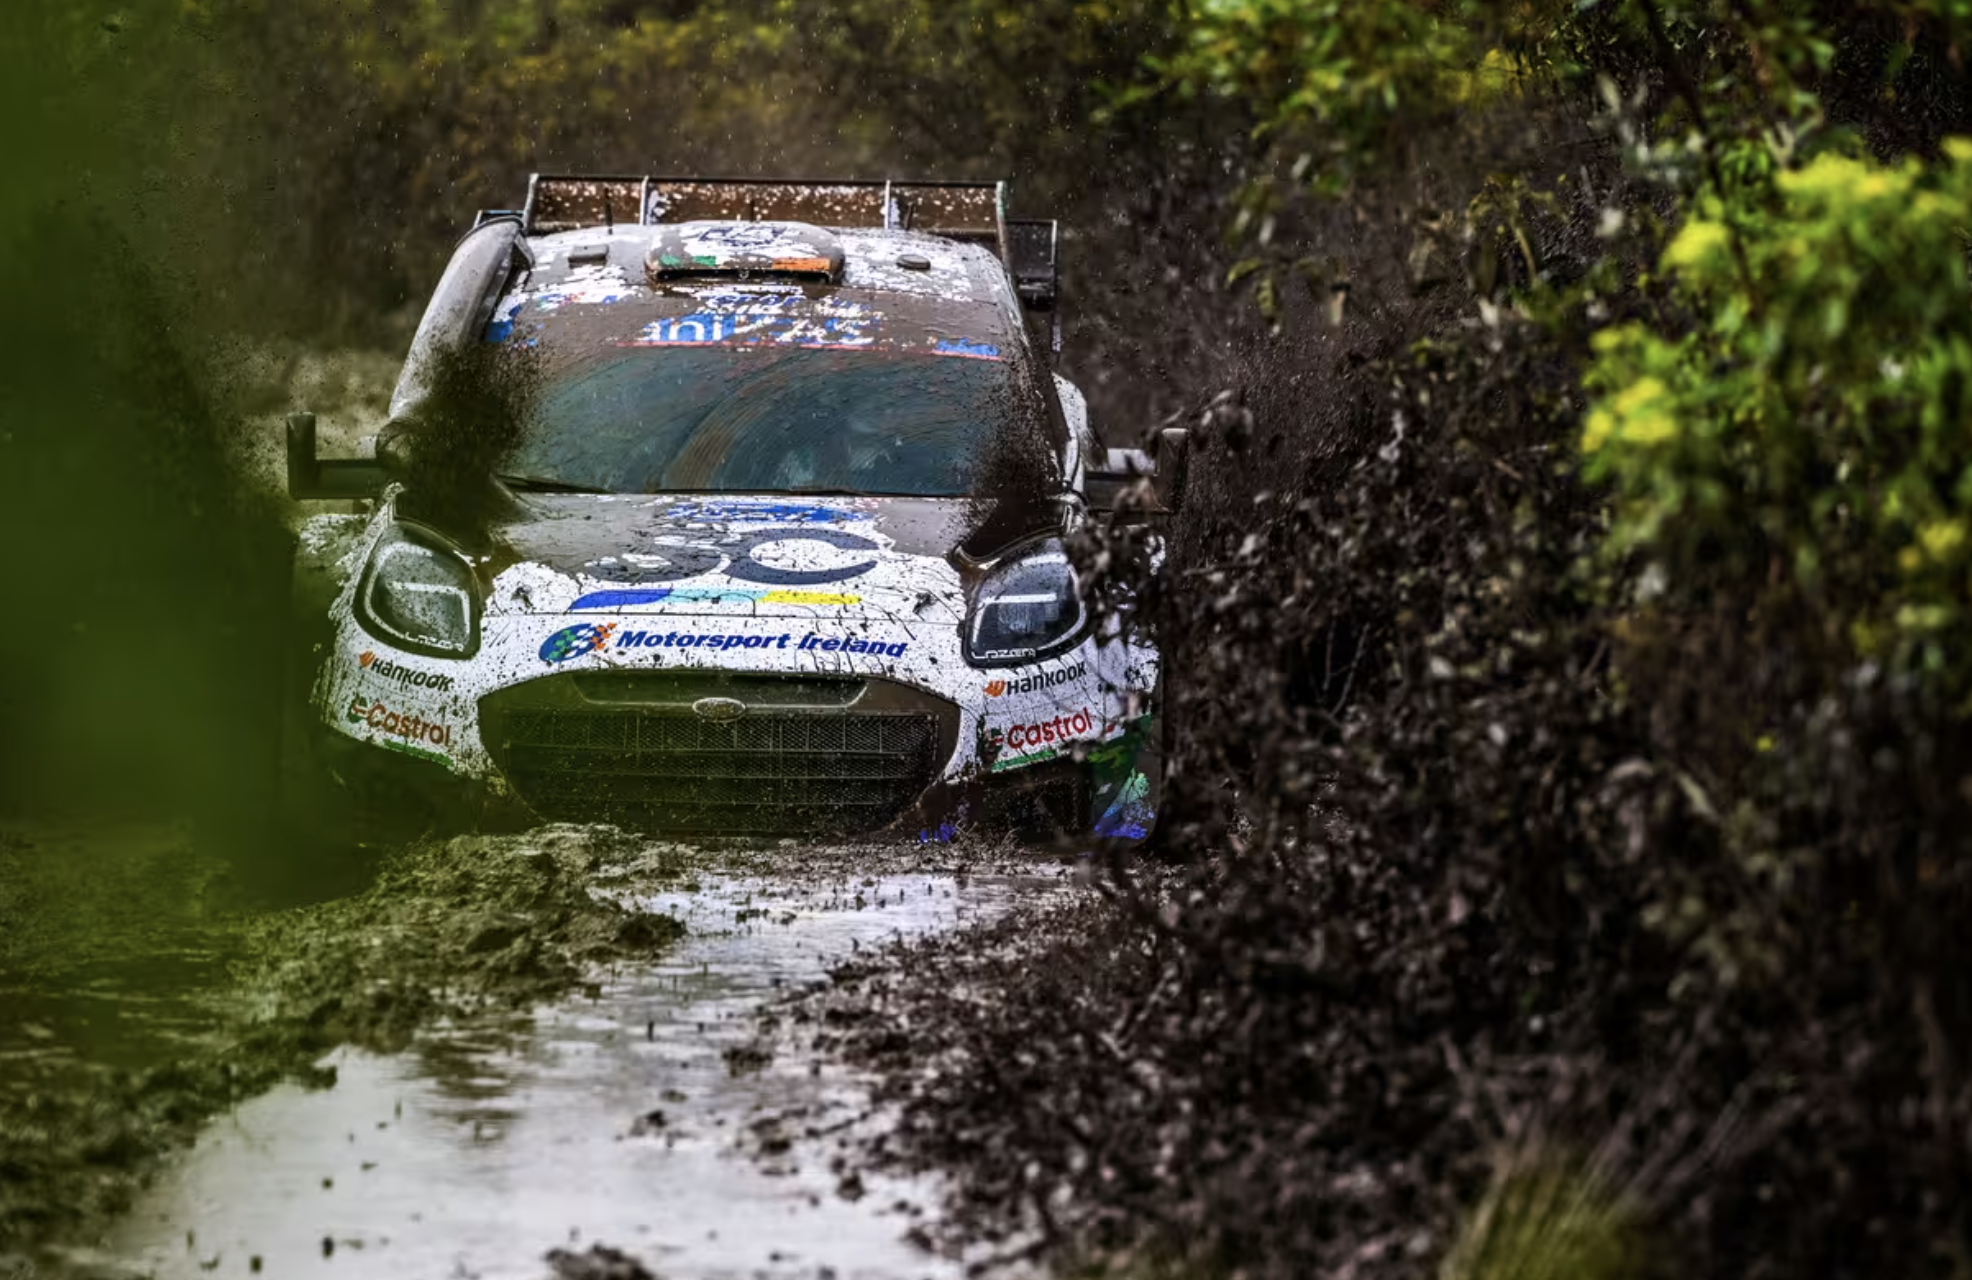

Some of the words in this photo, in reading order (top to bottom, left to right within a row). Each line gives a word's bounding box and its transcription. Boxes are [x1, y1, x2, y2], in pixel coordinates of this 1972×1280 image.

[615, 629, 791, 651] Motorsport
[797, 633, 908, 658] Ireland
[1007, 661, 1087, 695] Hankook
[366, 702, 452, 748] Castrol
[1007, 706, 1092, 749] Castrol
